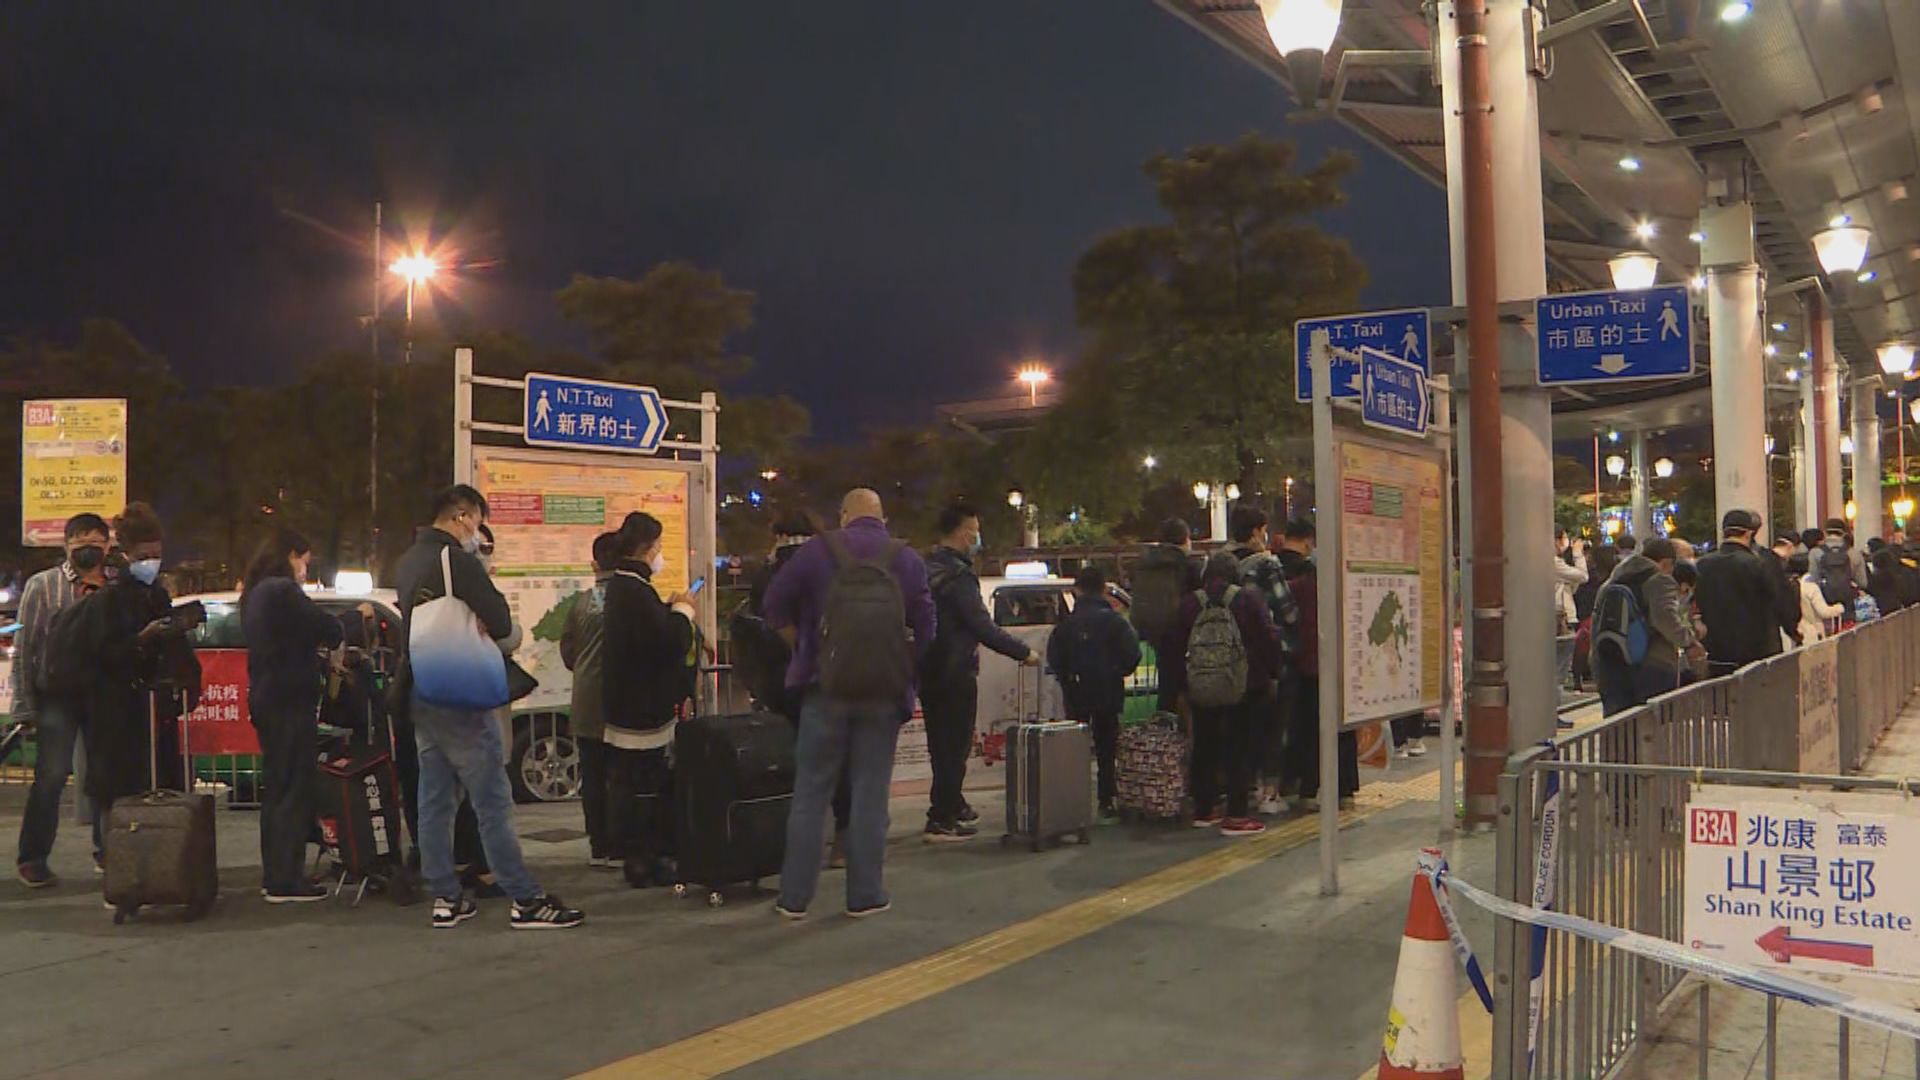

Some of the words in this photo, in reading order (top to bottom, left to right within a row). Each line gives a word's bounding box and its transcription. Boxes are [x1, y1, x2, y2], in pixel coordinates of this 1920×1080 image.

[1550, 302, 1604, 320] Urban
[1610, 298, 1646, 315] Taxi
[1351, 321, 1384, 337] Taxi
[1546, 321, 1651, 350] 市區的士
[1375, 362, 1397, 384] Urban
[1396, 369, 1412, 389] Taxi
[27, 407, 53, 424] B3A
[1376, 389, 1417, 422] 市區的士
[557, 412, 637, 440] 新界的士
[1541, 809, 1556, 860] CORDON
[1695, 811, 1733, 844] B3A
[1747, 815, 1816, 850] 兆康
[1837, 823, 1888, 847] 富泰
[1535, 860, 1551, 904] POLICE
[1727, 850, 1876, 903] 山景邨
[1705, 894, 1761, 917] Shan
[1770, 899, 1824, 928] King
[1834, 905, 1912, 931] Estate
